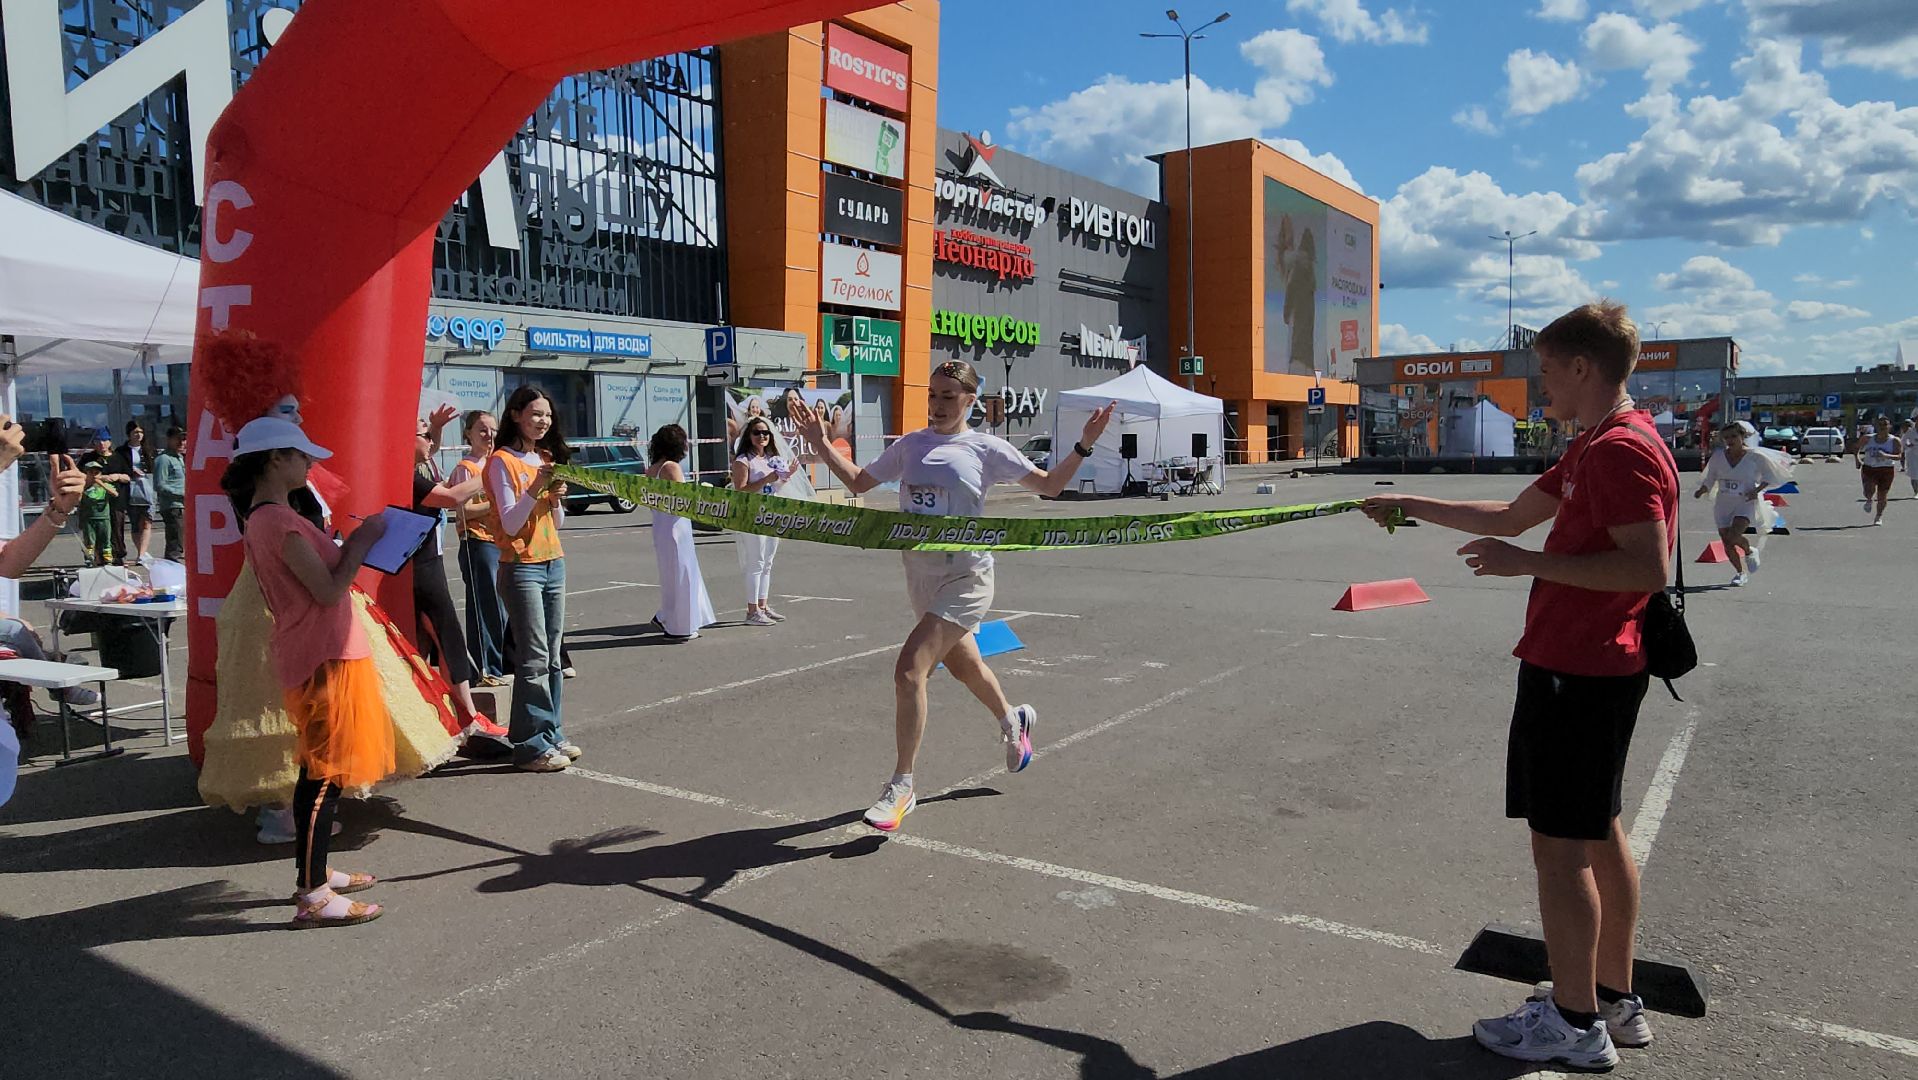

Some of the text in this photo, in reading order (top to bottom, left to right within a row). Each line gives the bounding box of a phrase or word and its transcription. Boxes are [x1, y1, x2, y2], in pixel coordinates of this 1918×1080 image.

[829, 48, 906, 91] ROSTIC'S
[838, 197, 889, 225] СУДАРЬ
[1070, 196, 1156, 249] РИВ ГОШ
[540, 239, 641, 279] МАСКА
[433, 267, 626, 316] ДЕКОРАЦИИ
[831, 277, 894, 304] Теремок
[533, 332, 649, 353] ФИЛЬТРЫ ДЛЯ ВОДЫ
[840, 323, 848, 338] 7
[859, 323, 866, 338] 7
[712, 332, 727, 361] P
[1184, 361, 1191, 371] 8
[1404, 361, 1453, 376] ОБОИ
[449, 378, 488, 389] Фильтры
[1312, 389, 1322, 401] P
[1001, 386, 1048, 415] DAY
[1738, 399, 1748, 411] P
[1827, 395, 1837, 407] P
[640, 486, 730, 519] Sergiev trail
[911, 492, 936, 508] 33
[754, 506, 859, 537] Sergiev trail
